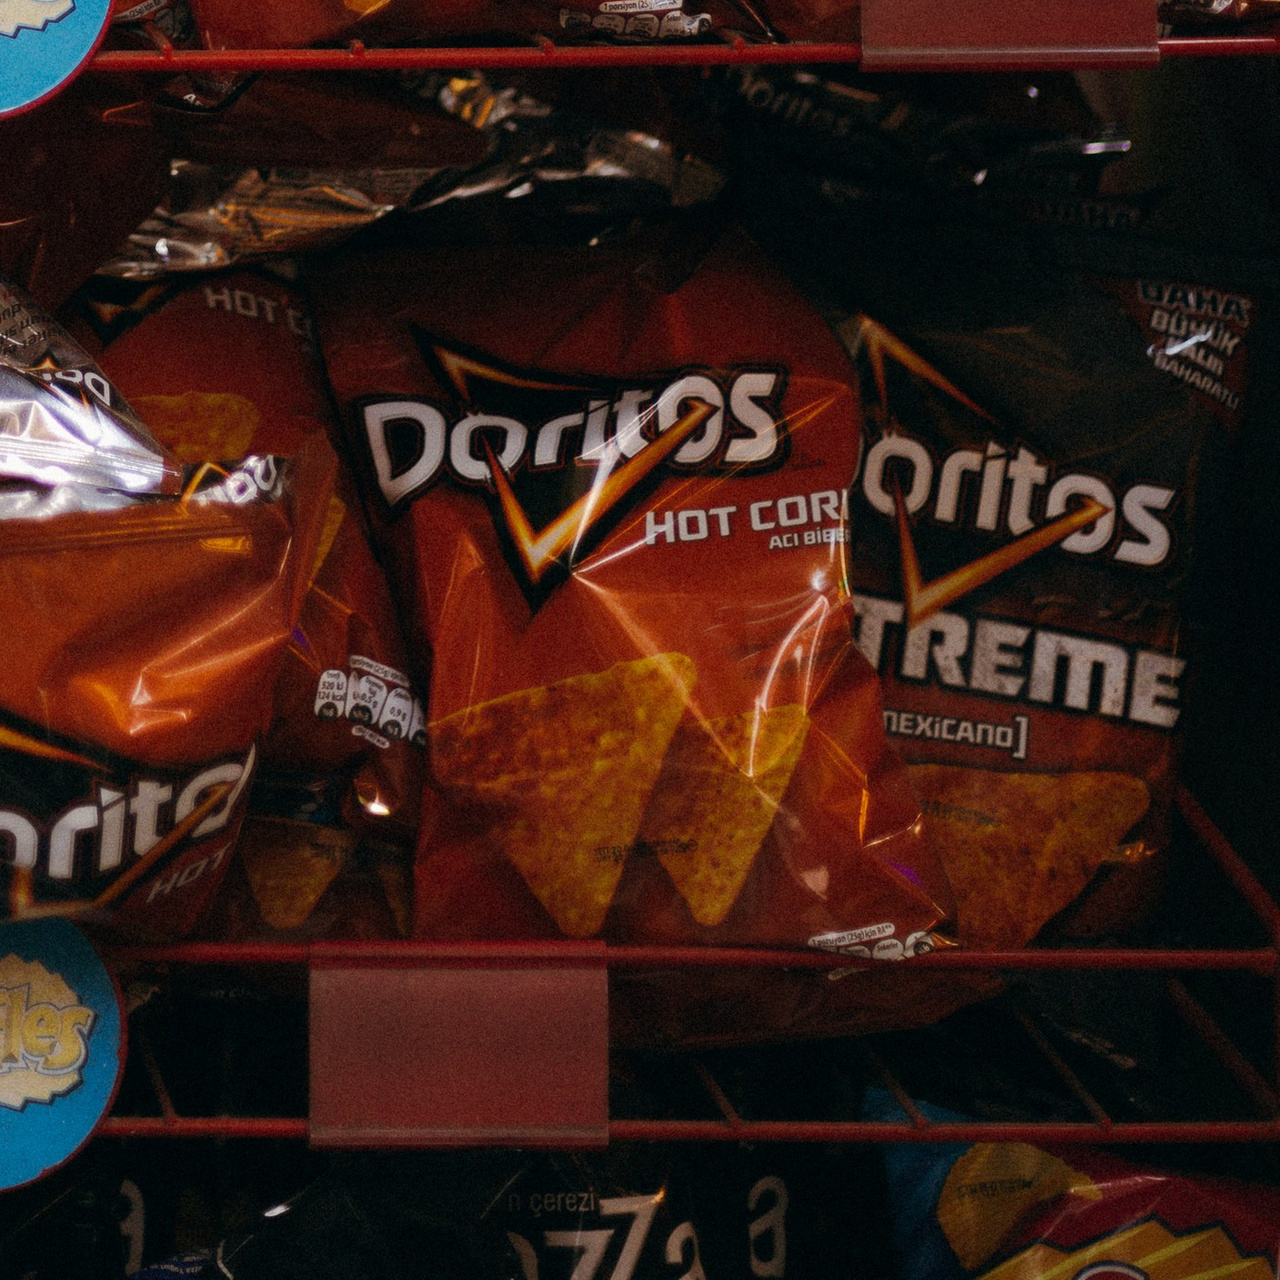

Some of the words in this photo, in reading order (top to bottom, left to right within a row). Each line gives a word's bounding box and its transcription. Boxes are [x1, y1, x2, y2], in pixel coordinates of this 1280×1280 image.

[362, 372, 779, 506] Doritos
[643, 504, 738, 545] HOT
[768, 529, 800, 550] ACI
[862, 428, 1177, 568] oritos
[853, 593, 1188, 730] TREME
[529, 1185, 596, 1219] çerezi
